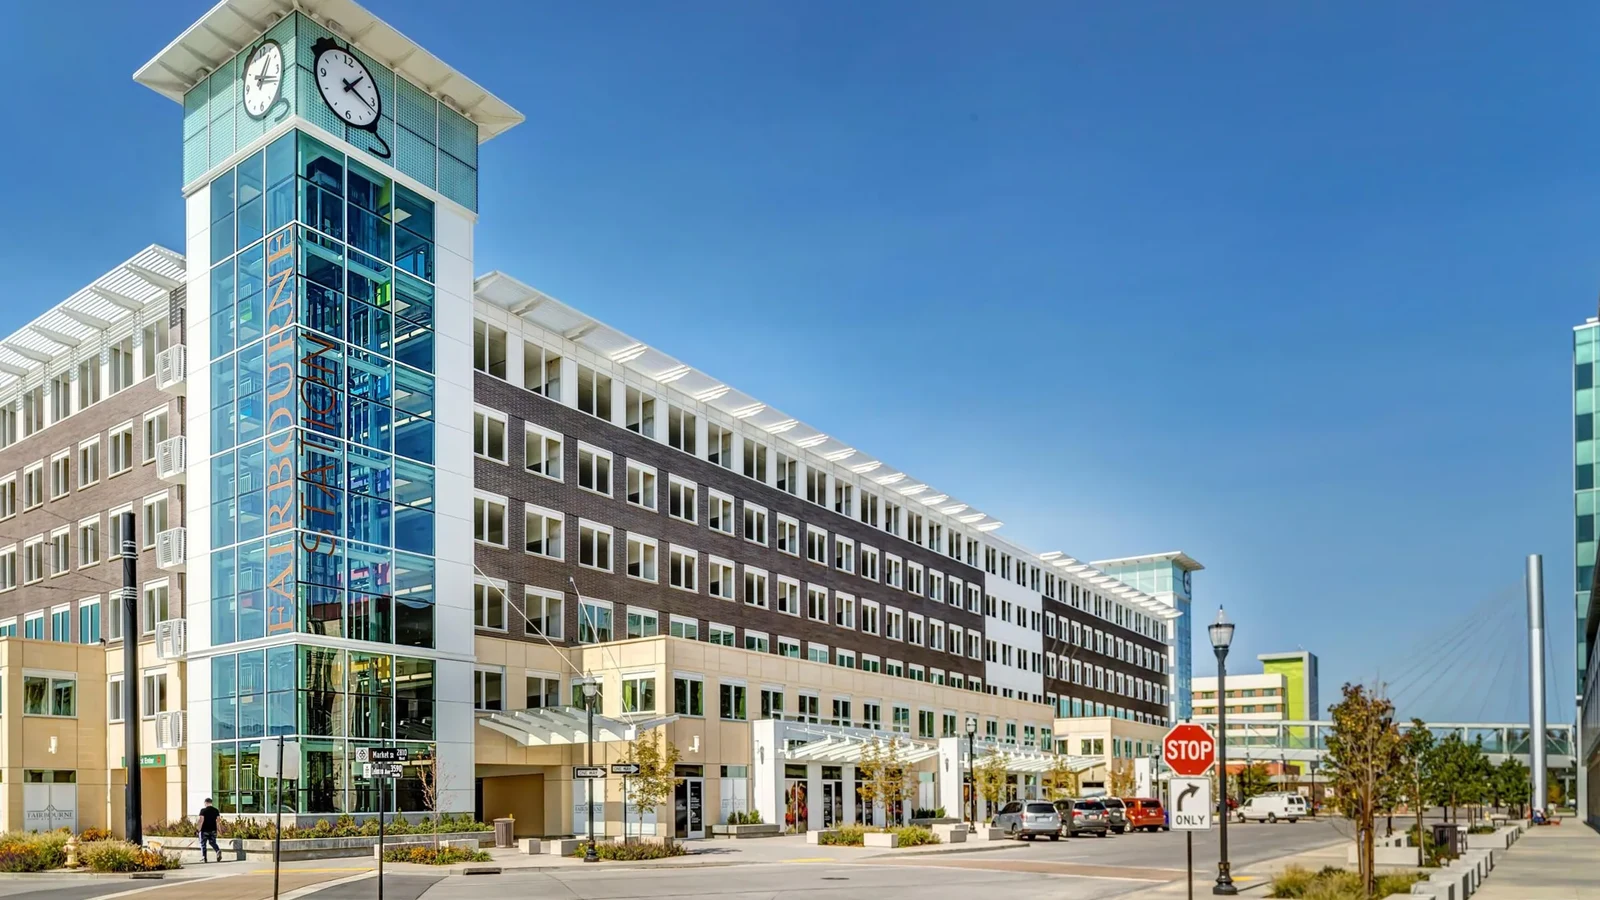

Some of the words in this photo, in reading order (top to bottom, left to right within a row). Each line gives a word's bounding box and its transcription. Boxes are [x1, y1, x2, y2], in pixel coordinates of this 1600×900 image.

[343, 54, 354, 68] 12
[320, 67, 327, 77] 9
[370, 97, 376, 107] 3
[345, 110, 351, 120] 6
[266, 224, 296, 635] FAIRBOURNE
[300, 333, 336, 557] STATION
[1166, 739, 1212, 760] STOP
[1176, 815, 1205, 825] ONLY
